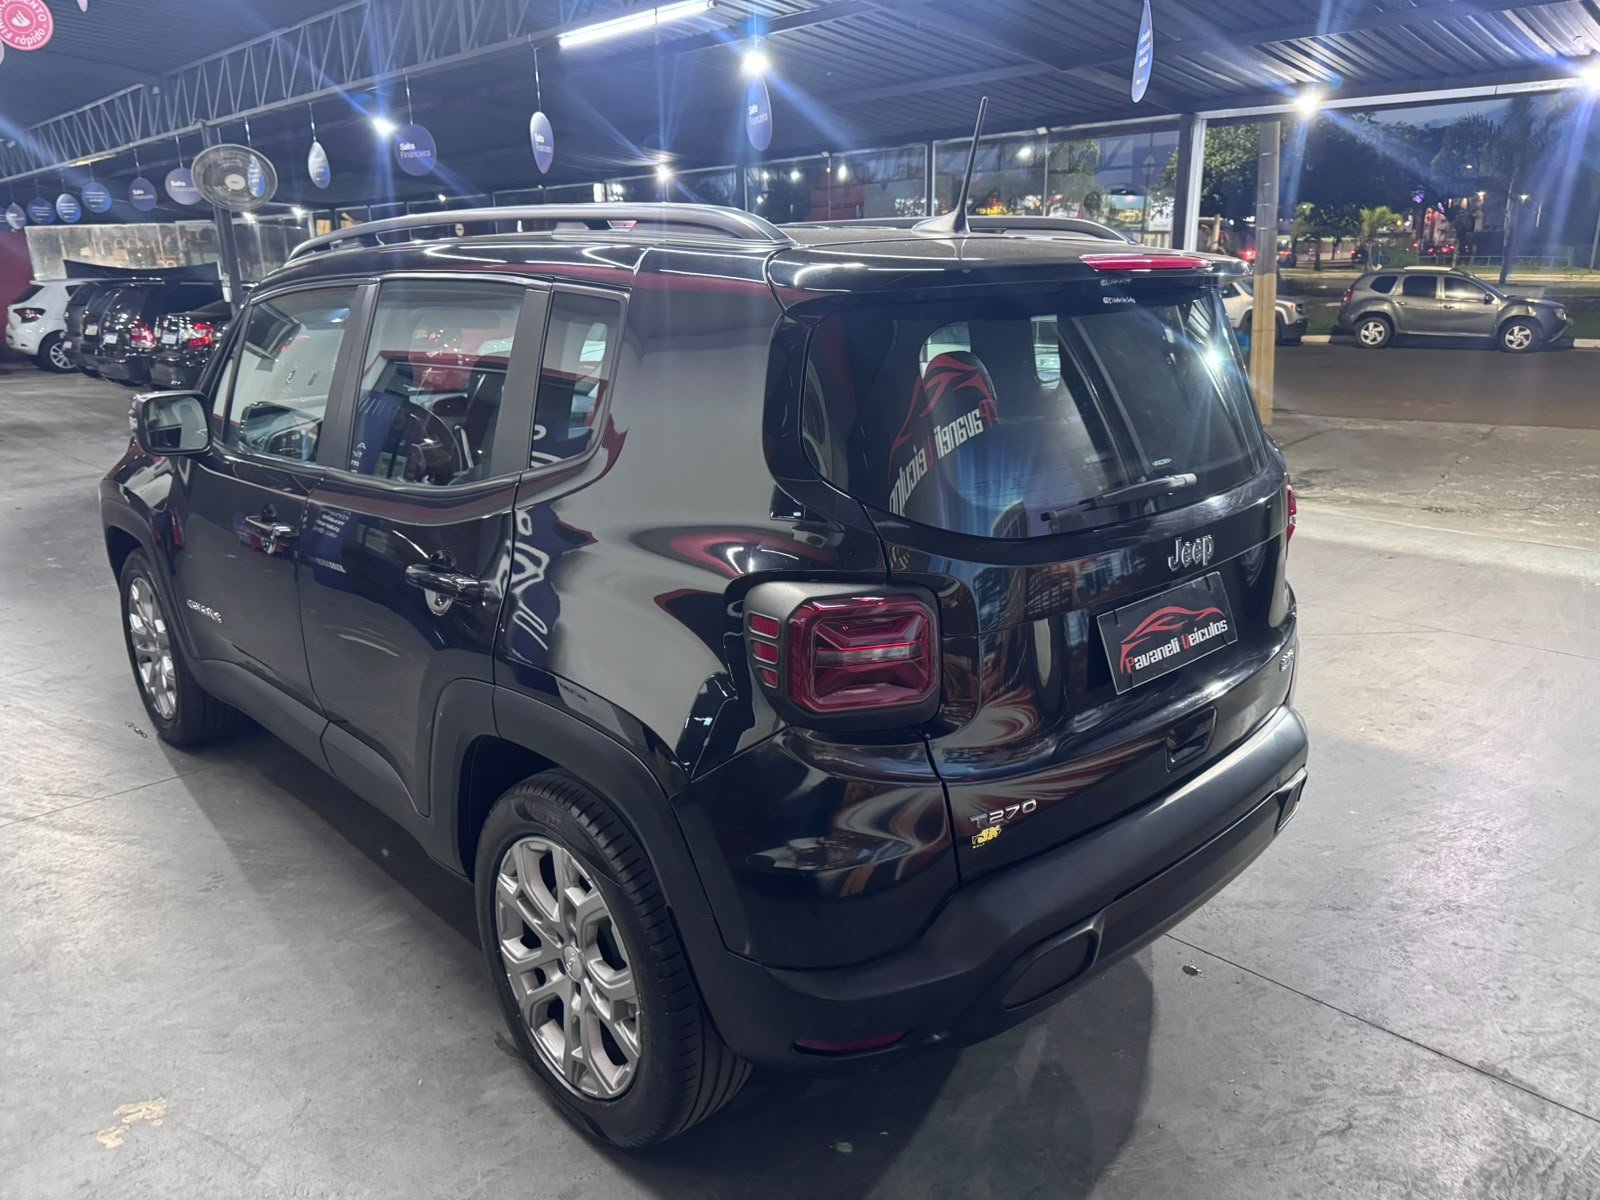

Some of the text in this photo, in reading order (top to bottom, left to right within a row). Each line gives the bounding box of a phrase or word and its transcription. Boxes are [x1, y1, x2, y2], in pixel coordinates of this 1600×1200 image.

[1168, 534, 1214, 571] Jeep
[1125, 637, 1180, 674] Pavaneli
[970, 799, 1037, 829] T270
